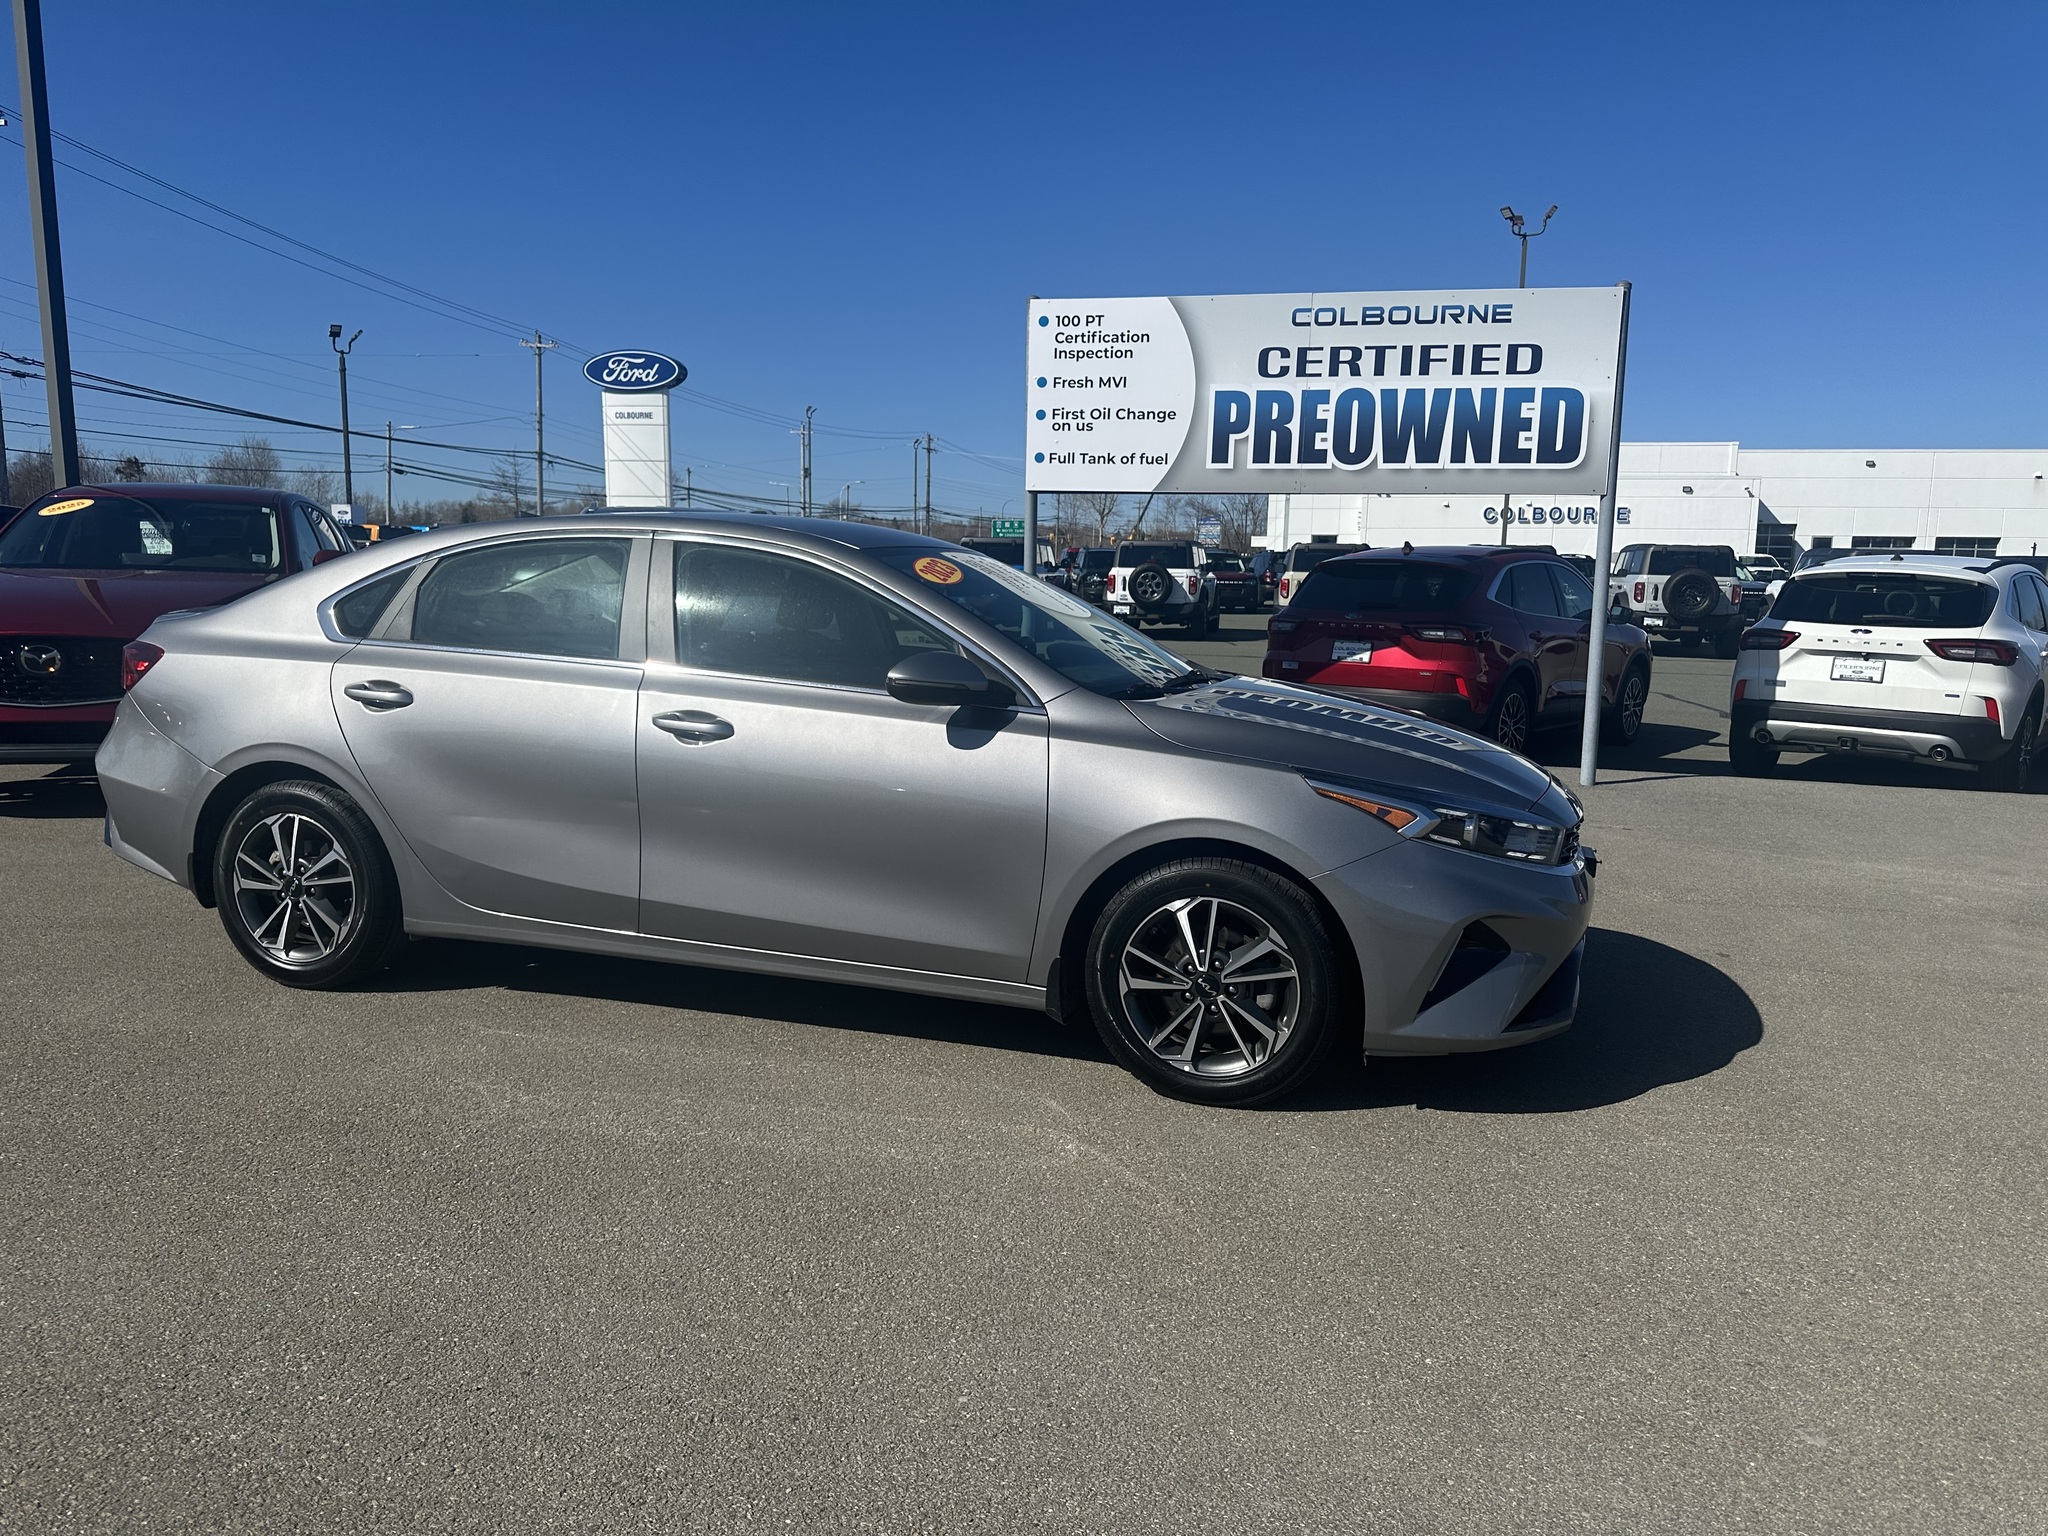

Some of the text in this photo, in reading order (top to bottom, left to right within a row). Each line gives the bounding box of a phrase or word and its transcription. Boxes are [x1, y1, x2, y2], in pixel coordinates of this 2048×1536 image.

[1055, 314, 1105, 327] 100 PT
[1291, 303, 1513, 327] COLBOURNE
[1054, 330, 1150, 344] Certification
[1053, 346, 1134, 362] Inspection
[1257, 343, 1543, 379] CERTIFIED
[602, 356, 660, 382] Ford
[1053, 376, 1127, 388] Fresh MVI
[614, 411, 653, 420] COLBOURNE
[1051, 407, 1177, 423] First Oil Change
[1051, 422, 1094, 432] on us
[1208, 385, 1588, 468] PREOWNED
[1049, 452, 1168, 465] Full Tank of fuel
[1483, 506, 1631, 524] COLBOURE
[918, 558, 958, 583] 2023
